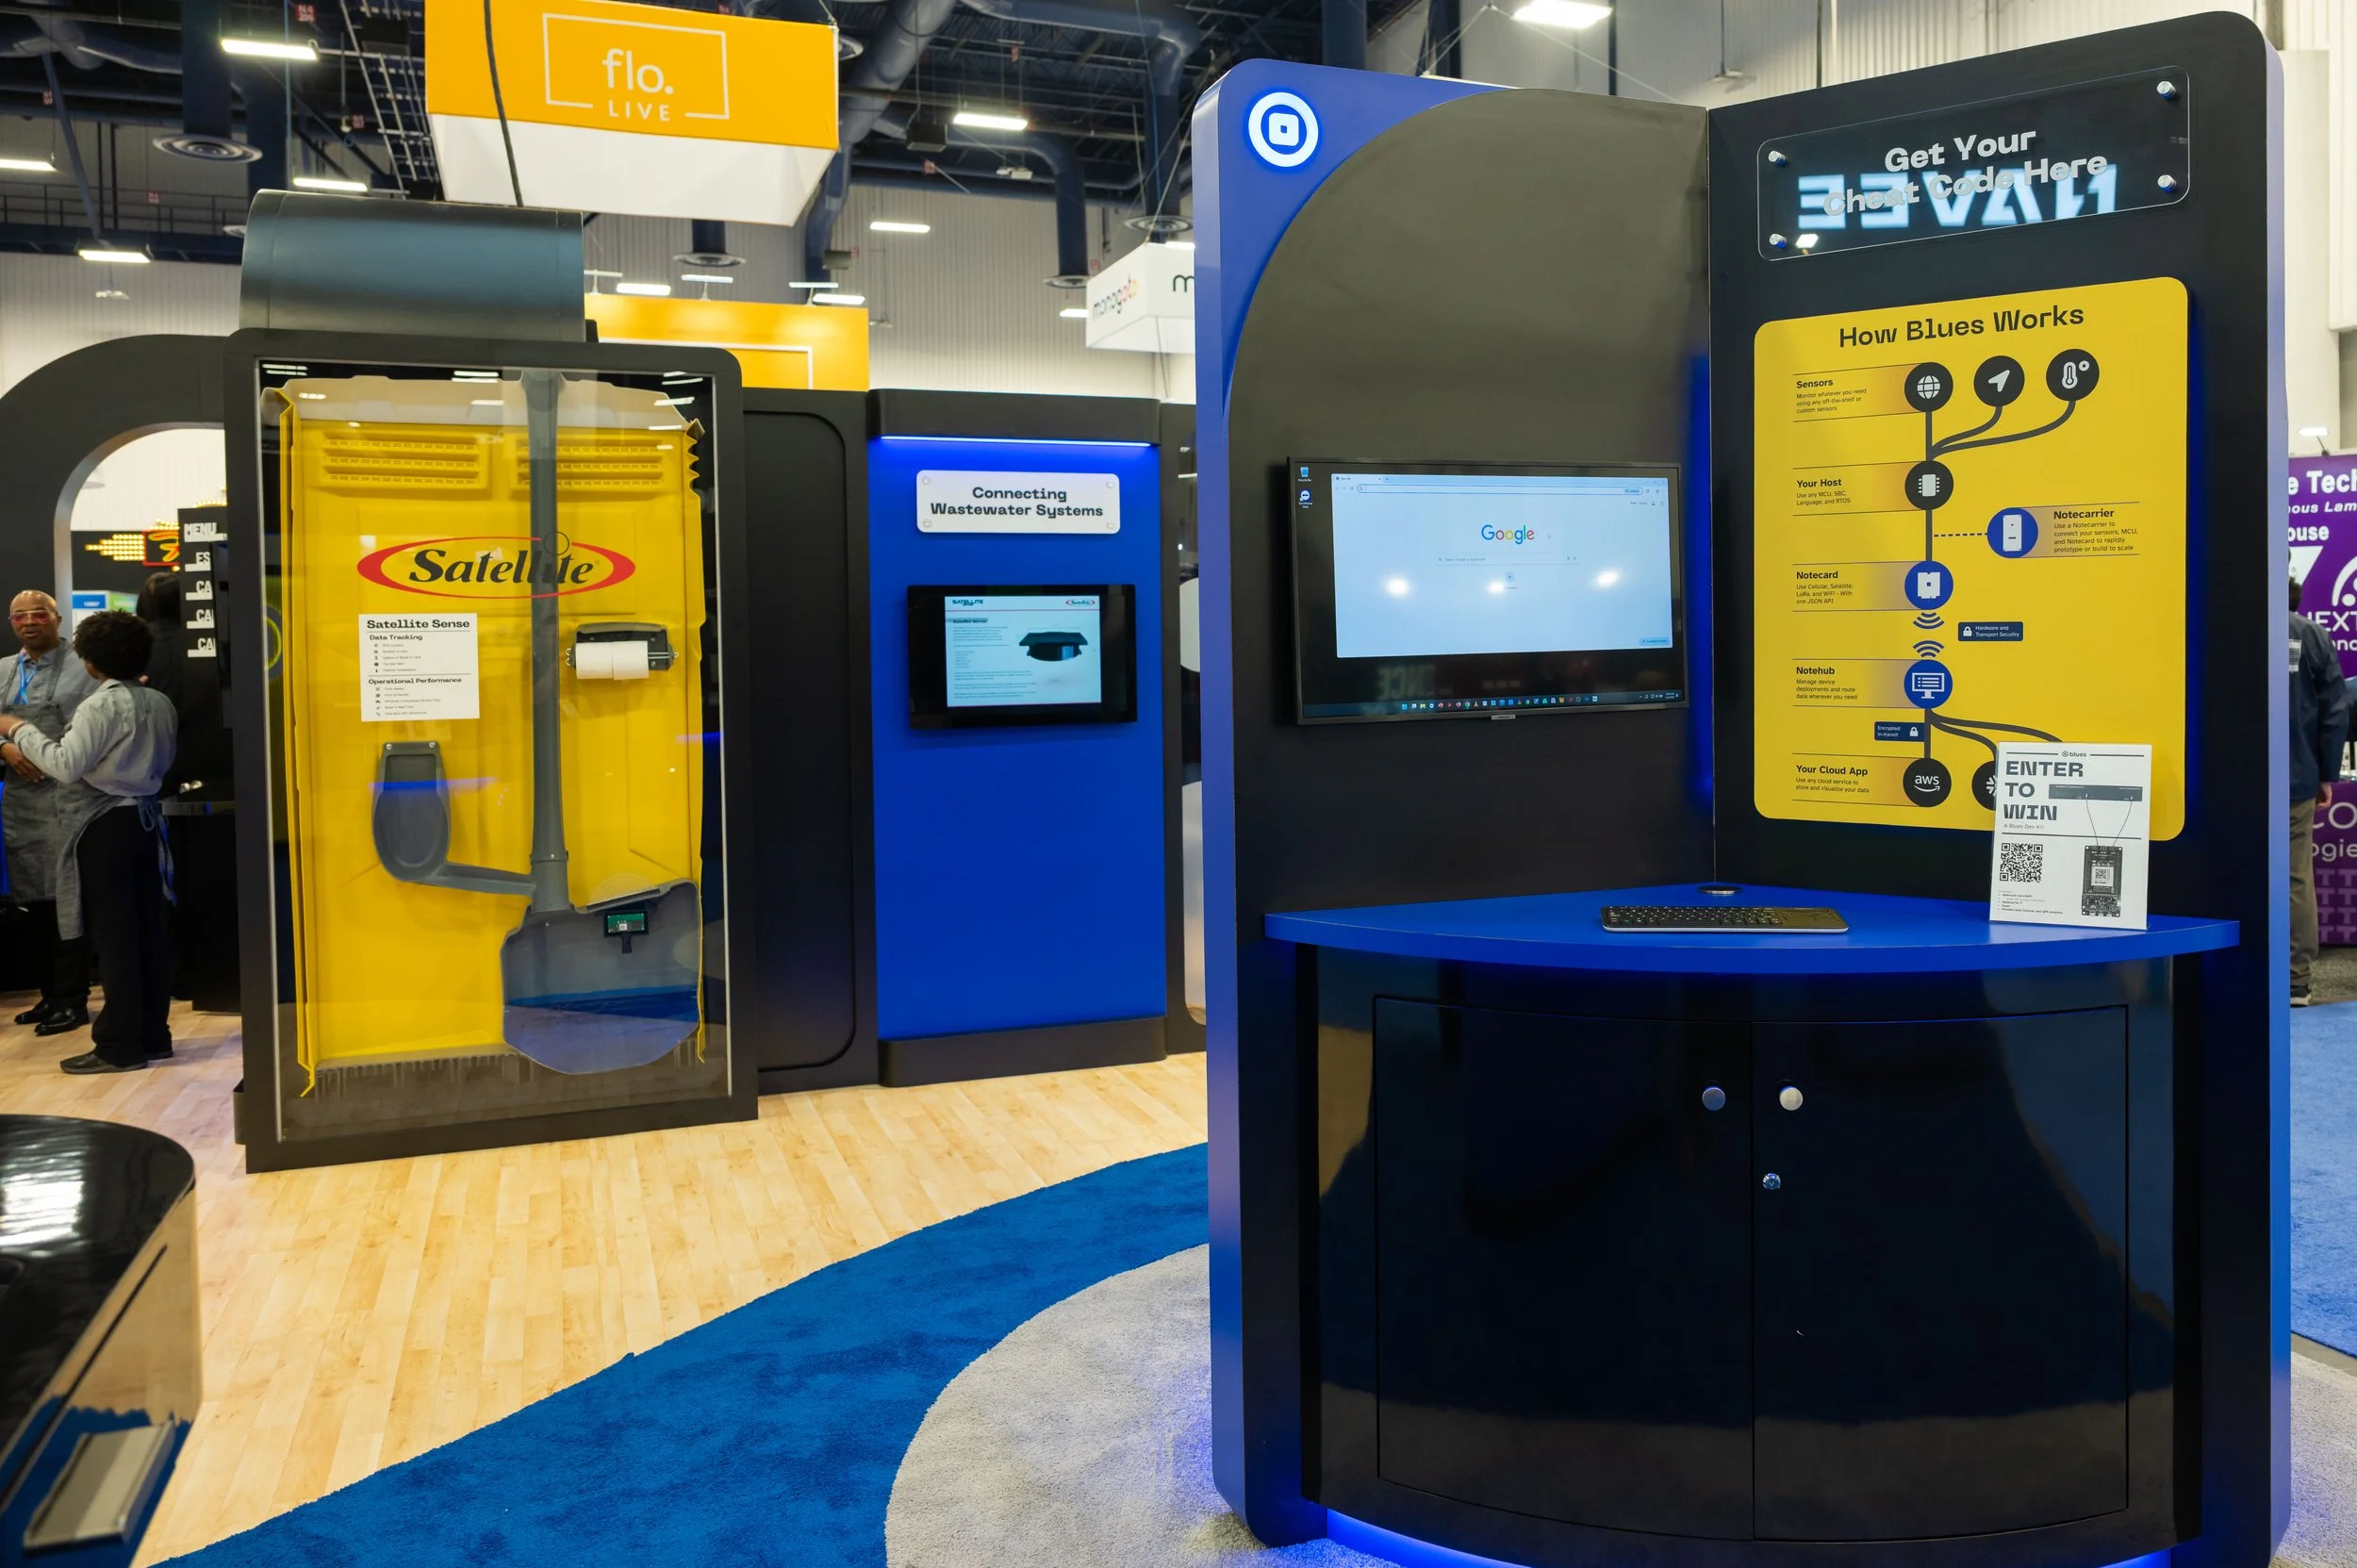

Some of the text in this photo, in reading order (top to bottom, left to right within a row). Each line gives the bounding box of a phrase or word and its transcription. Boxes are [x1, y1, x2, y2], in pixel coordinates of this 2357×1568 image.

[602, 48, 674, 95] flo.
[608, 99, 671, 122] LIVE
[1885, 129, 2036, 173] Get Your
[1822, 154, 2108, 218] Cheat Code Here
[1840, 305, 2085, 348] How Blues Works
[1797, 379, 1834, 389] Sensors
[1797, 479, 1842, 488] Your Host
[972, 487, 1067, 503] Connecting
[930, 503, 1104, 520] Wastewater Systems
[2053, 508, 2115, 520] Notecarrier
[184, 522, 218, 536] MENU
[1481, 524, 1535, 545] Google
[408, 549, 593, 585] Satellite
[1797, 571, 1838, 579] Notecard
[367, 619, 470, 629] Satellite Sense
[1796, 666, 1835, 675] Notehub
[1796, 765, 1869, 777] Your Cloud App
[2005, 760, 2084, 777] ENTER
[1914, 775, 1940, 785] aws
[2005, 782, 2035, 798] TO
[2003, 804, 2057, 821] WIN
